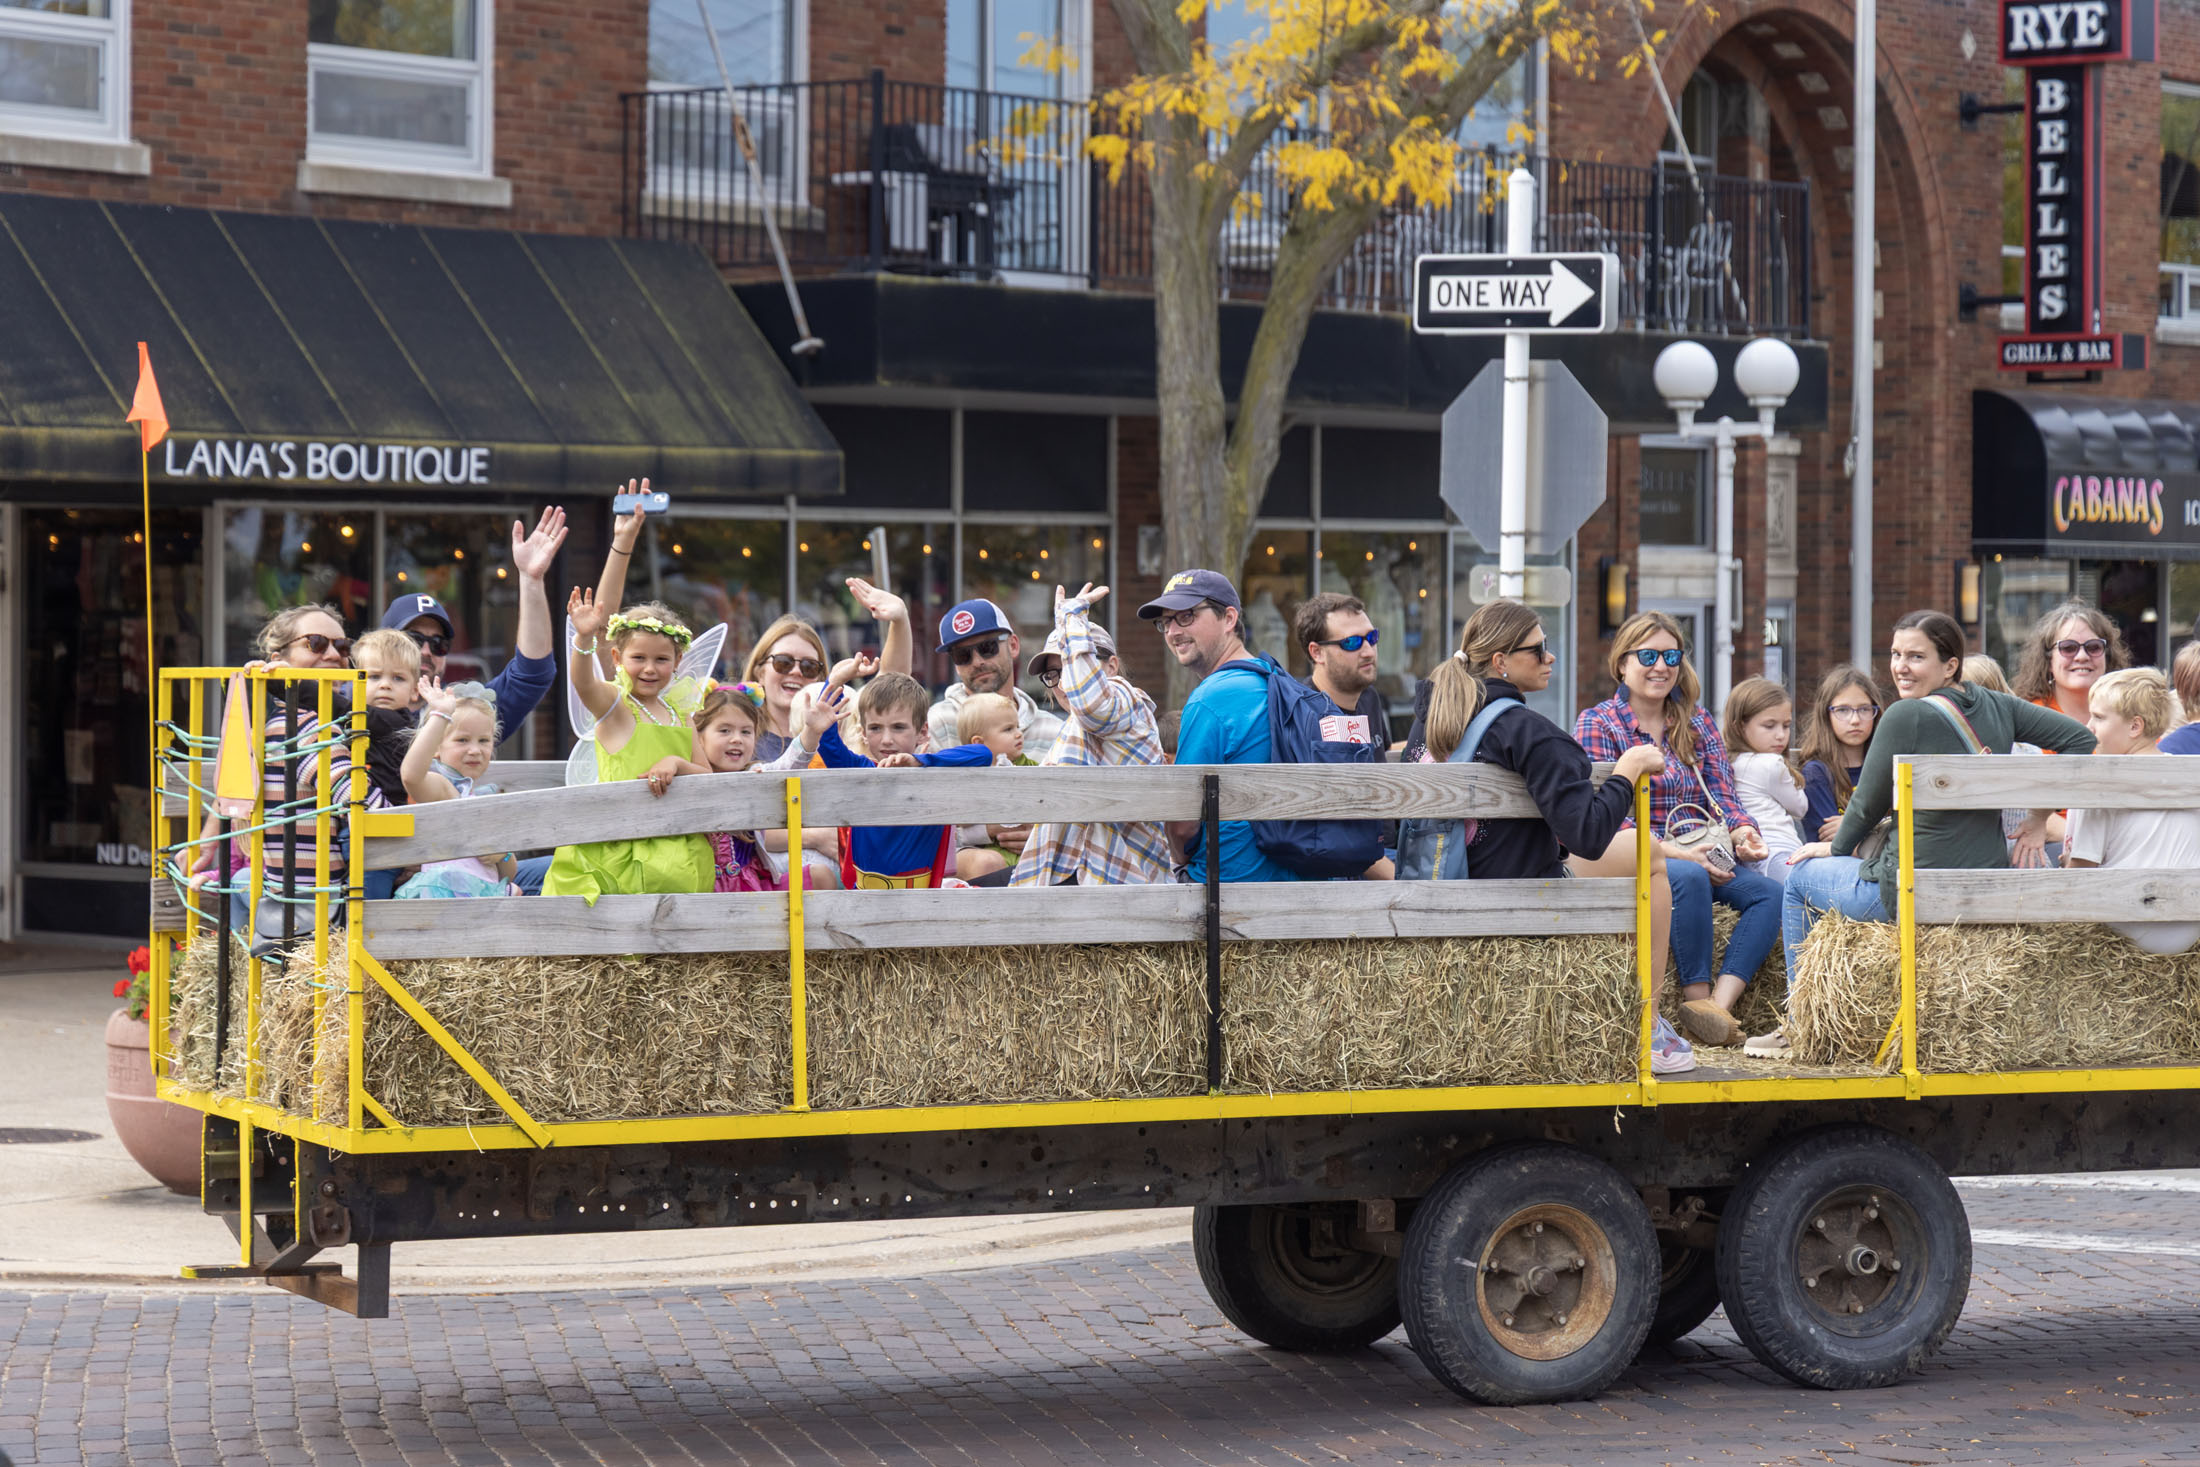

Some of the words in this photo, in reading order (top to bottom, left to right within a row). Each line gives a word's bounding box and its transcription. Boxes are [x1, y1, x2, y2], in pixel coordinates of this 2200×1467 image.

[2008, 2, 2108, 51] RYE
[2036, 78, 2069, 320] BELLES
[1437, 280, 1490, 307] ONE
[1500, 279, 1551, 307] WAY
[2003, 343, 2058, 363] GRILL
[2061, 342, 2074, 361] &
[2078, 341, 2112, 361] BAR
[165, 438, 297, 480] LANA'S
[306, 442, 489, 484] BOUTIQUE
[2053, 475, 2164, 536] CABANAS
[96, 842, 122, 865] NU
